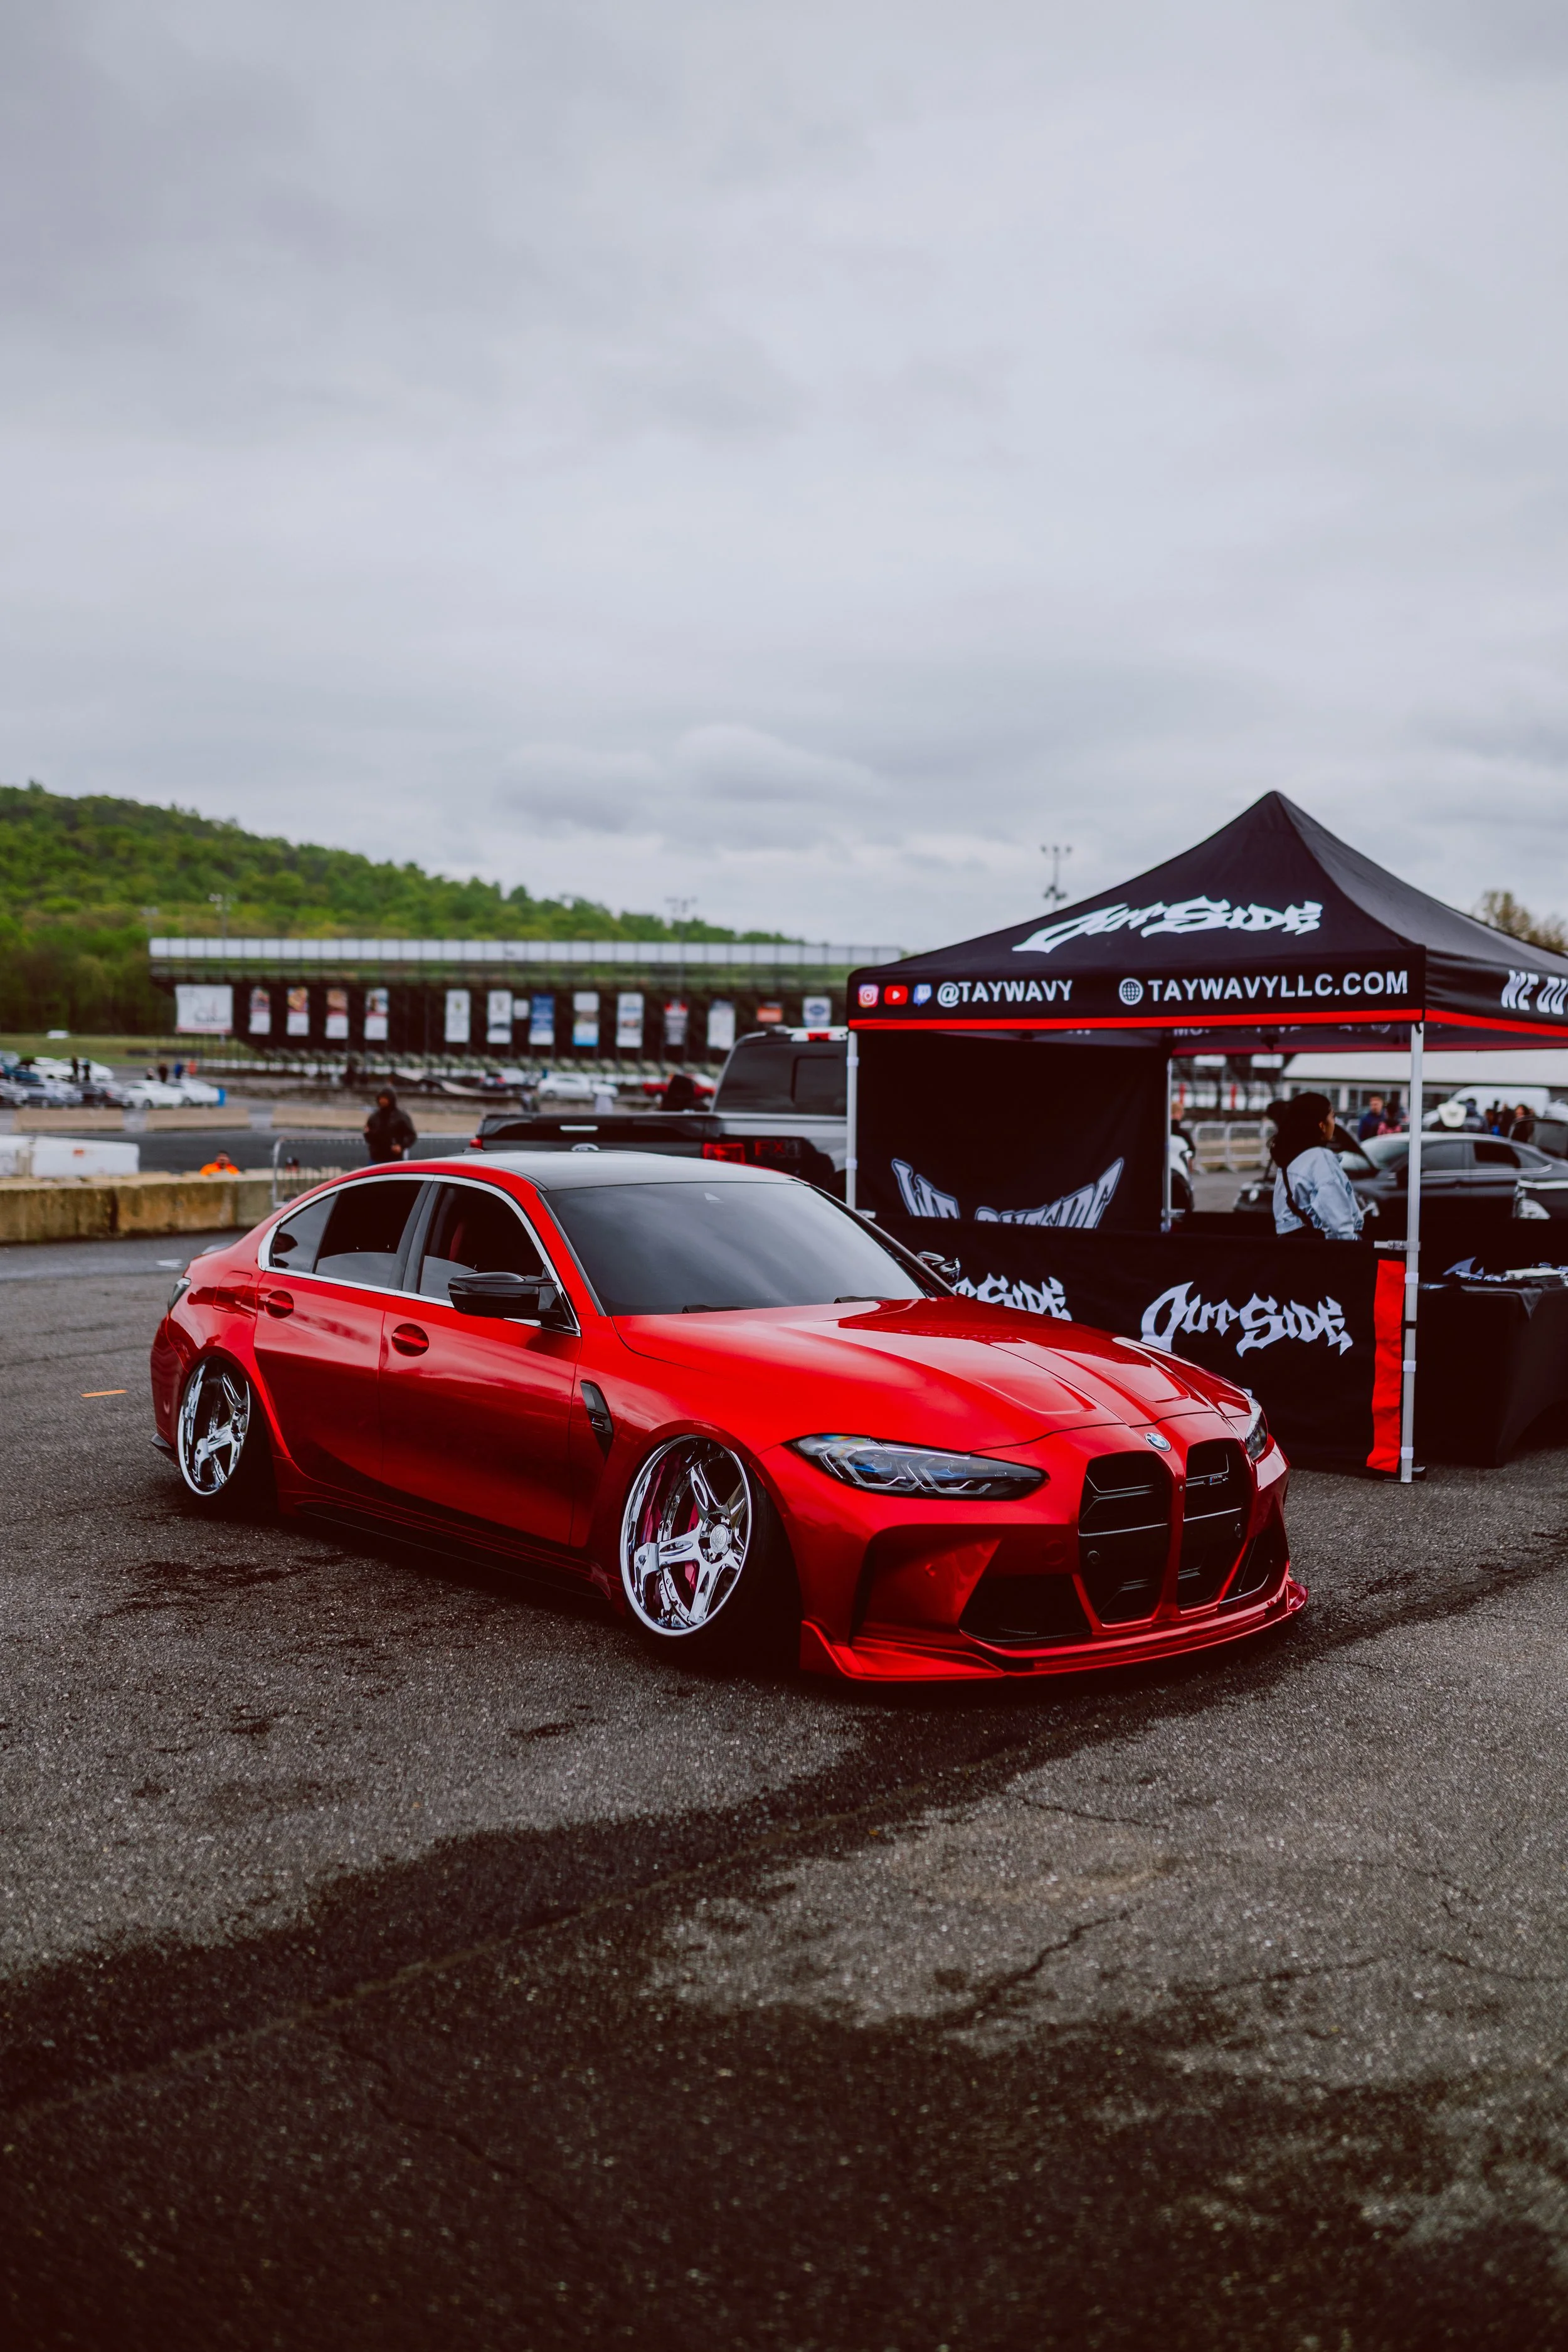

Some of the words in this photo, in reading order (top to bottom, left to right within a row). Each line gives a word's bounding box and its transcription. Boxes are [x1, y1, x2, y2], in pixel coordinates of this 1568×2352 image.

[937, 980, 1073, 1008] @TAYWAVY
[1148, 970, 1408, 1002] TAYWAVYLLC.COM
[1501, 970, 1539, 1010] WE
[1537, 976, 1568, 1015] OU
